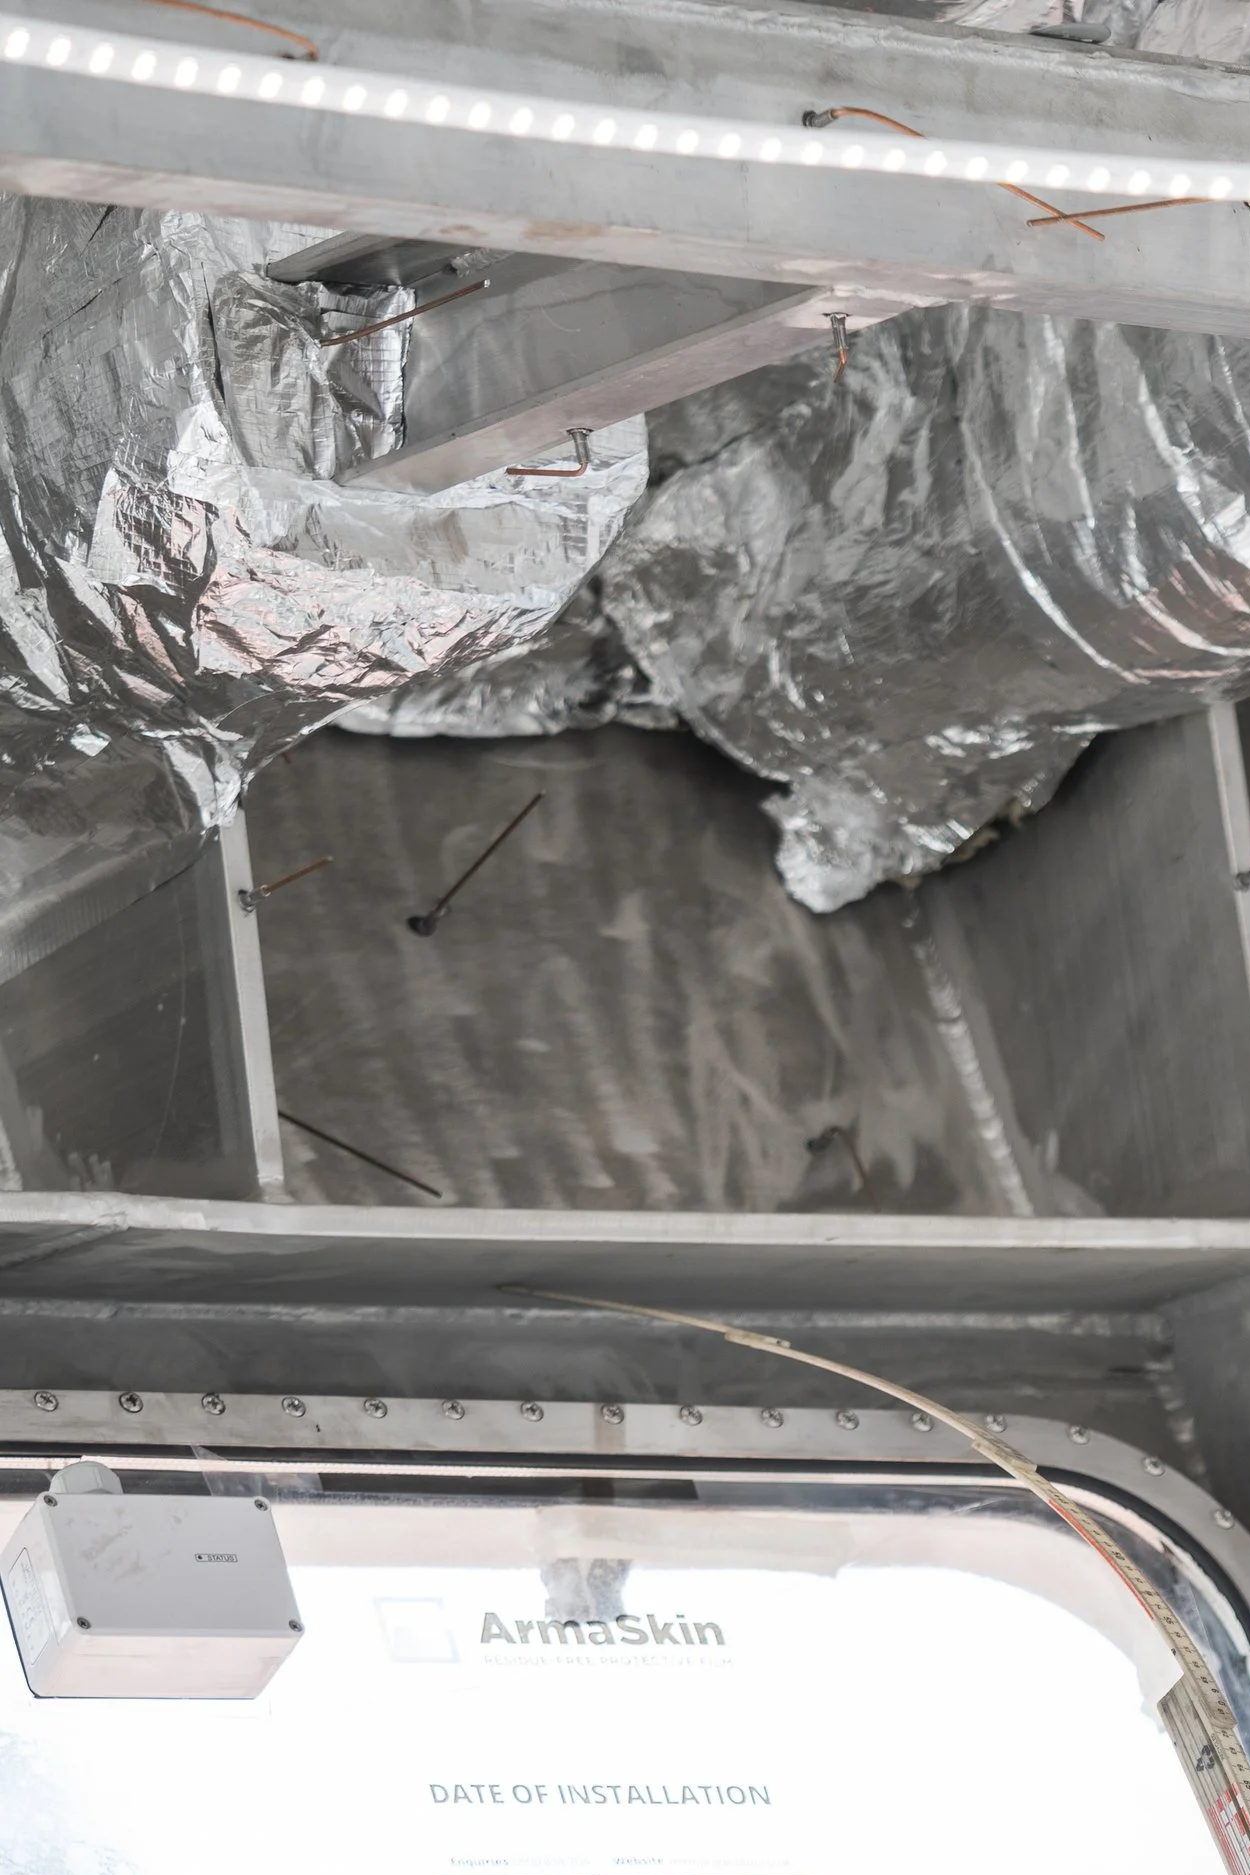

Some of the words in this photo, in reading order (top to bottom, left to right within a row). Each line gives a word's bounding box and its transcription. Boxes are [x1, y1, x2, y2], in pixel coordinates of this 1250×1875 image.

[480, 1612, 727, 1646] ArmaSkin
[429, 1784, 505, 1804] DATE
[511, 1784, 548, 1804] OF
[557, 1784, 772, 1805] INSTALLATION
